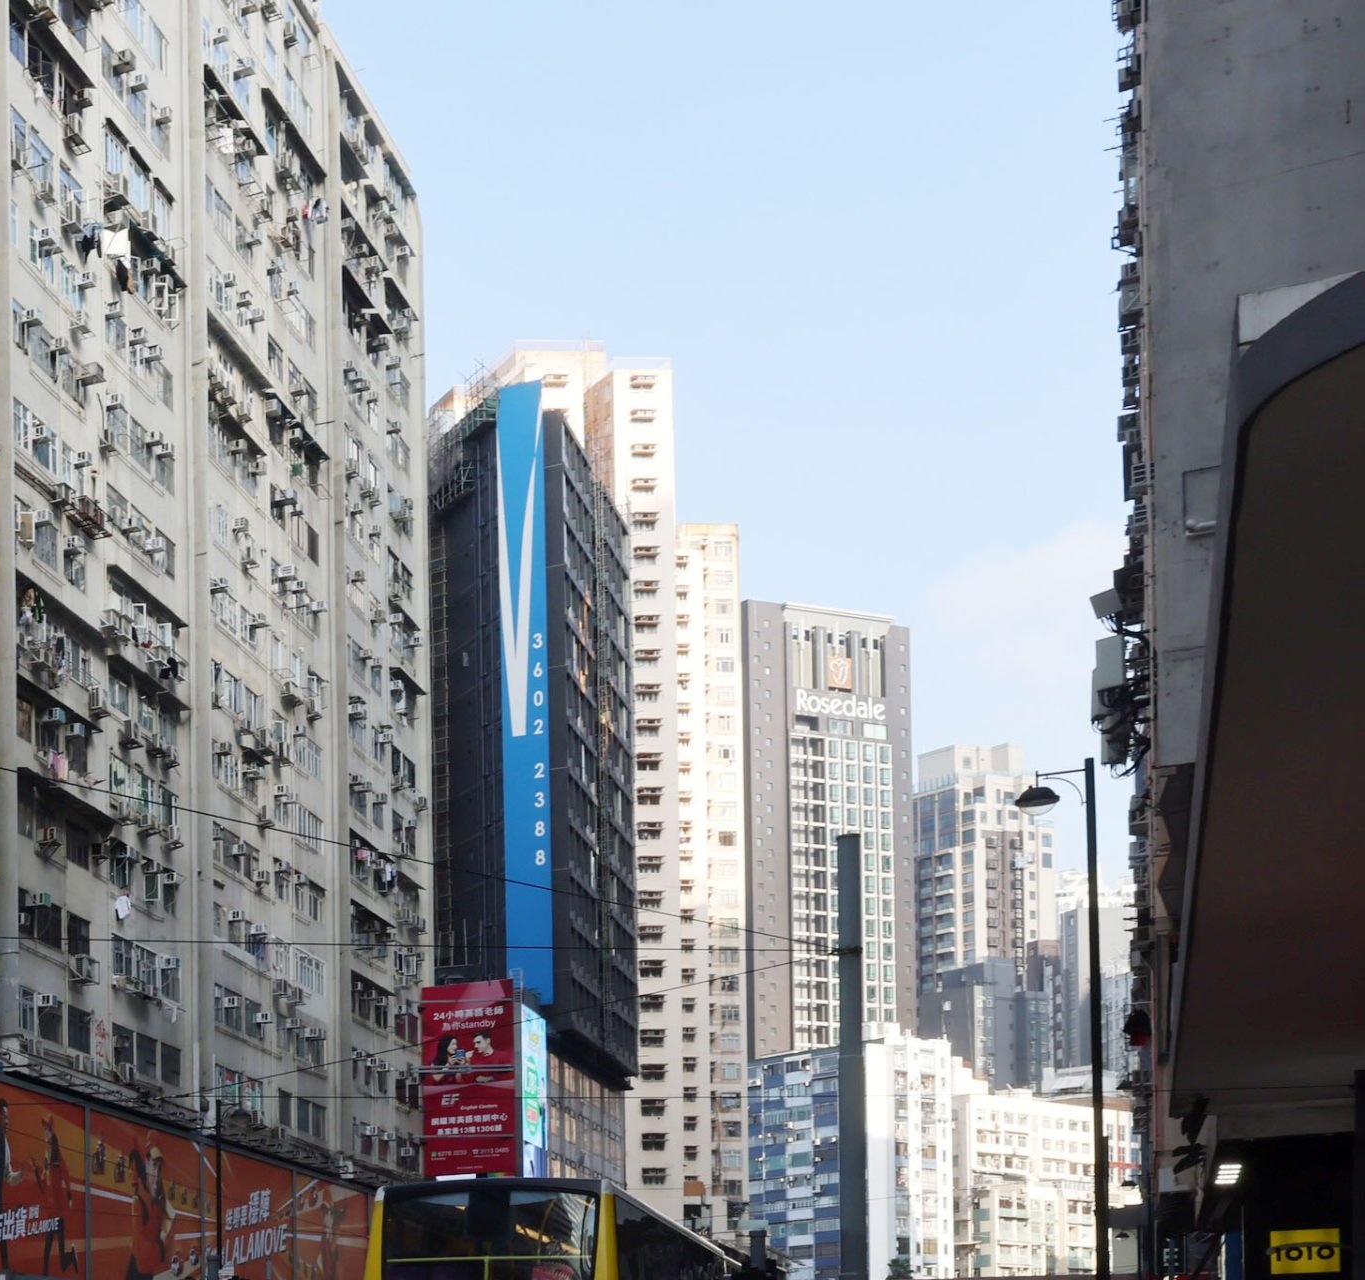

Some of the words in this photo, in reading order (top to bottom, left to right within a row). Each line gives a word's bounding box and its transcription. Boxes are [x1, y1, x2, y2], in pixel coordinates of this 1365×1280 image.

[531, 632, 545, 736] 3602
[795, 688, 886, 721] Rosedale
[533, 761, 547, 867] 2388
[441, 1019, 497, 1033] 為你standby
[440, 1093, 460, 1106] EF
[27, 1216, 60, 1236] LALAMOVE
[224, 1223, 288, 1267] LALAMOVE
